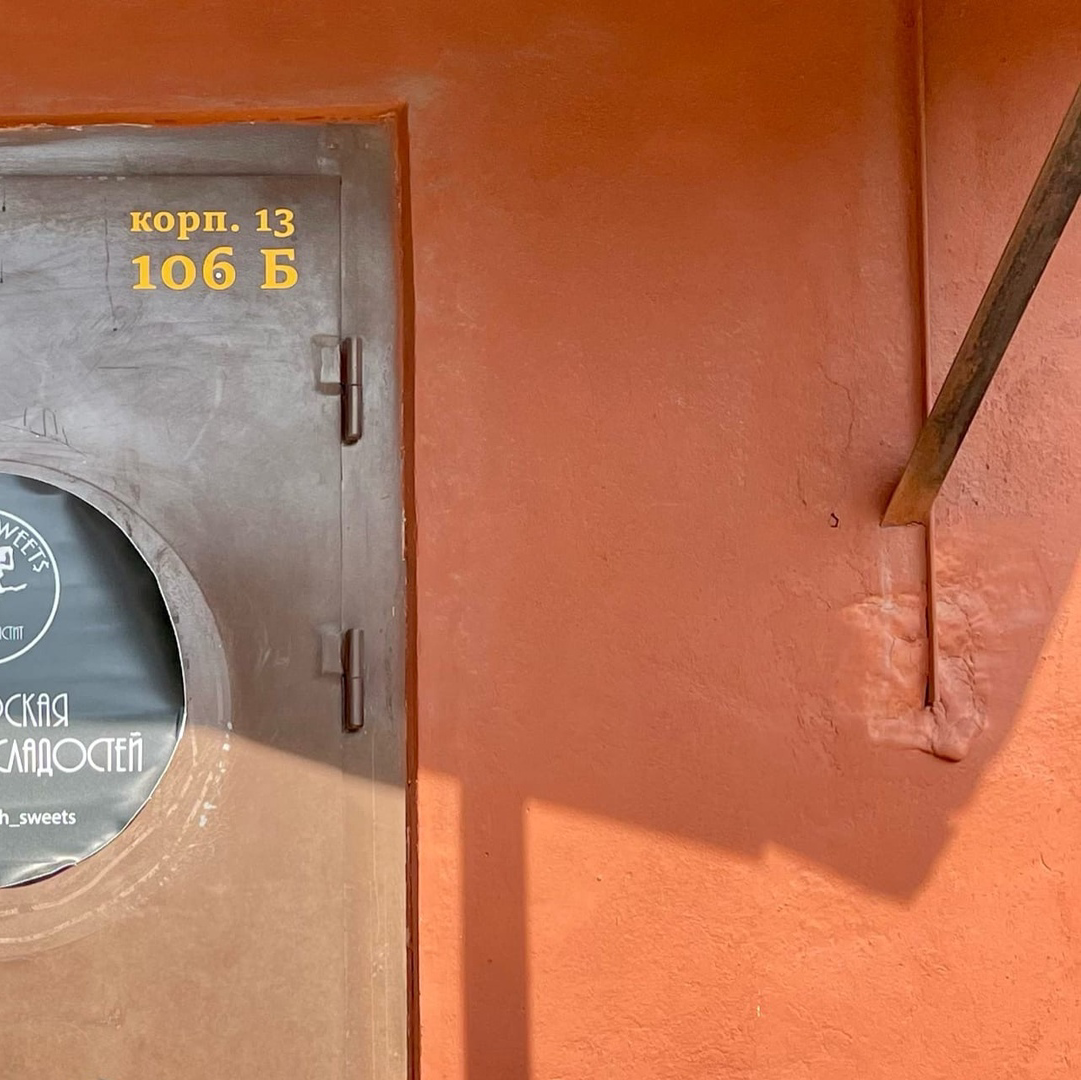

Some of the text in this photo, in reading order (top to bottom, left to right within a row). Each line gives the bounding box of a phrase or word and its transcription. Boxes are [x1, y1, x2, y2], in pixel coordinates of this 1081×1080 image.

[129, 208, 296, 241] корп. 13
[131, 246, 299, 291] 106 Б
